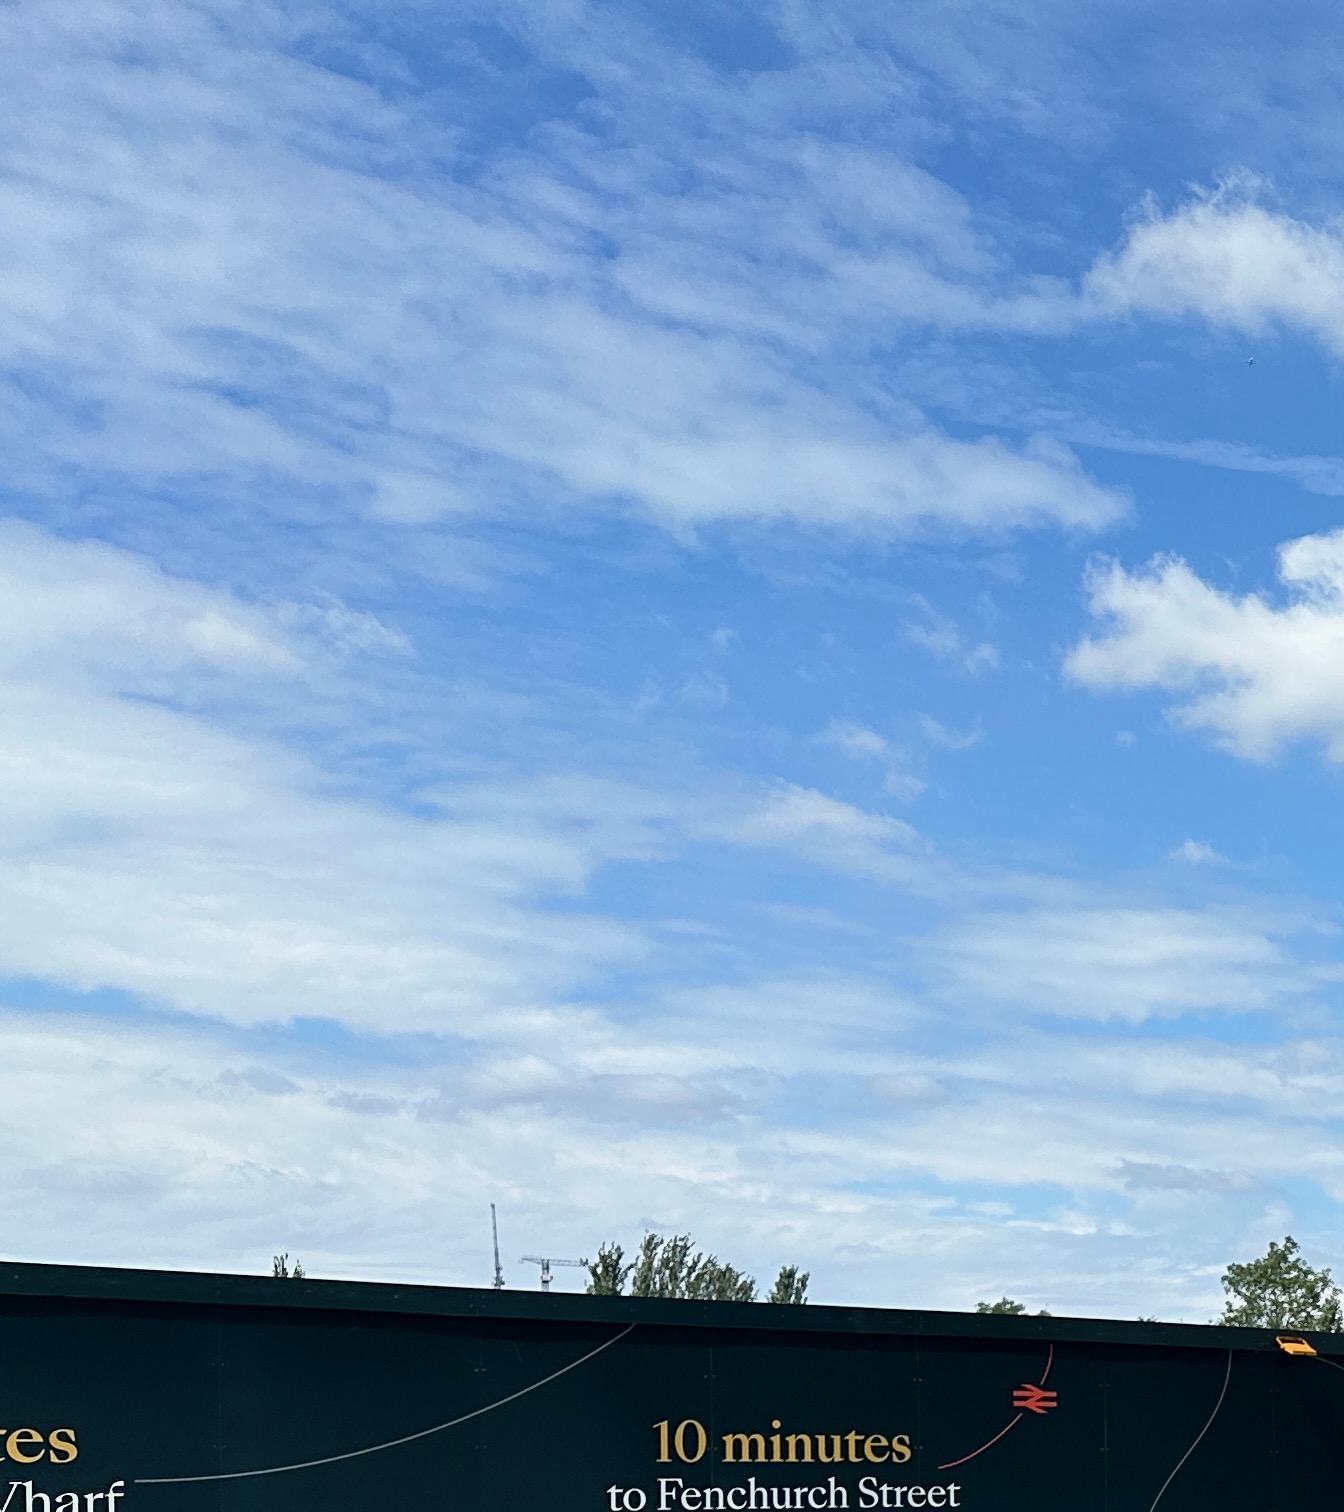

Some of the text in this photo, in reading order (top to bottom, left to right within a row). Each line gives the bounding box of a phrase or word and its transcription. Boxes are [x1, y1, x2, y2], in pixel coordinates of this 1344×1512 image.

[652, 1419, 912, 1463] 10 minutes
[606, 1476, 962, 1512] to Fenchurch Street
